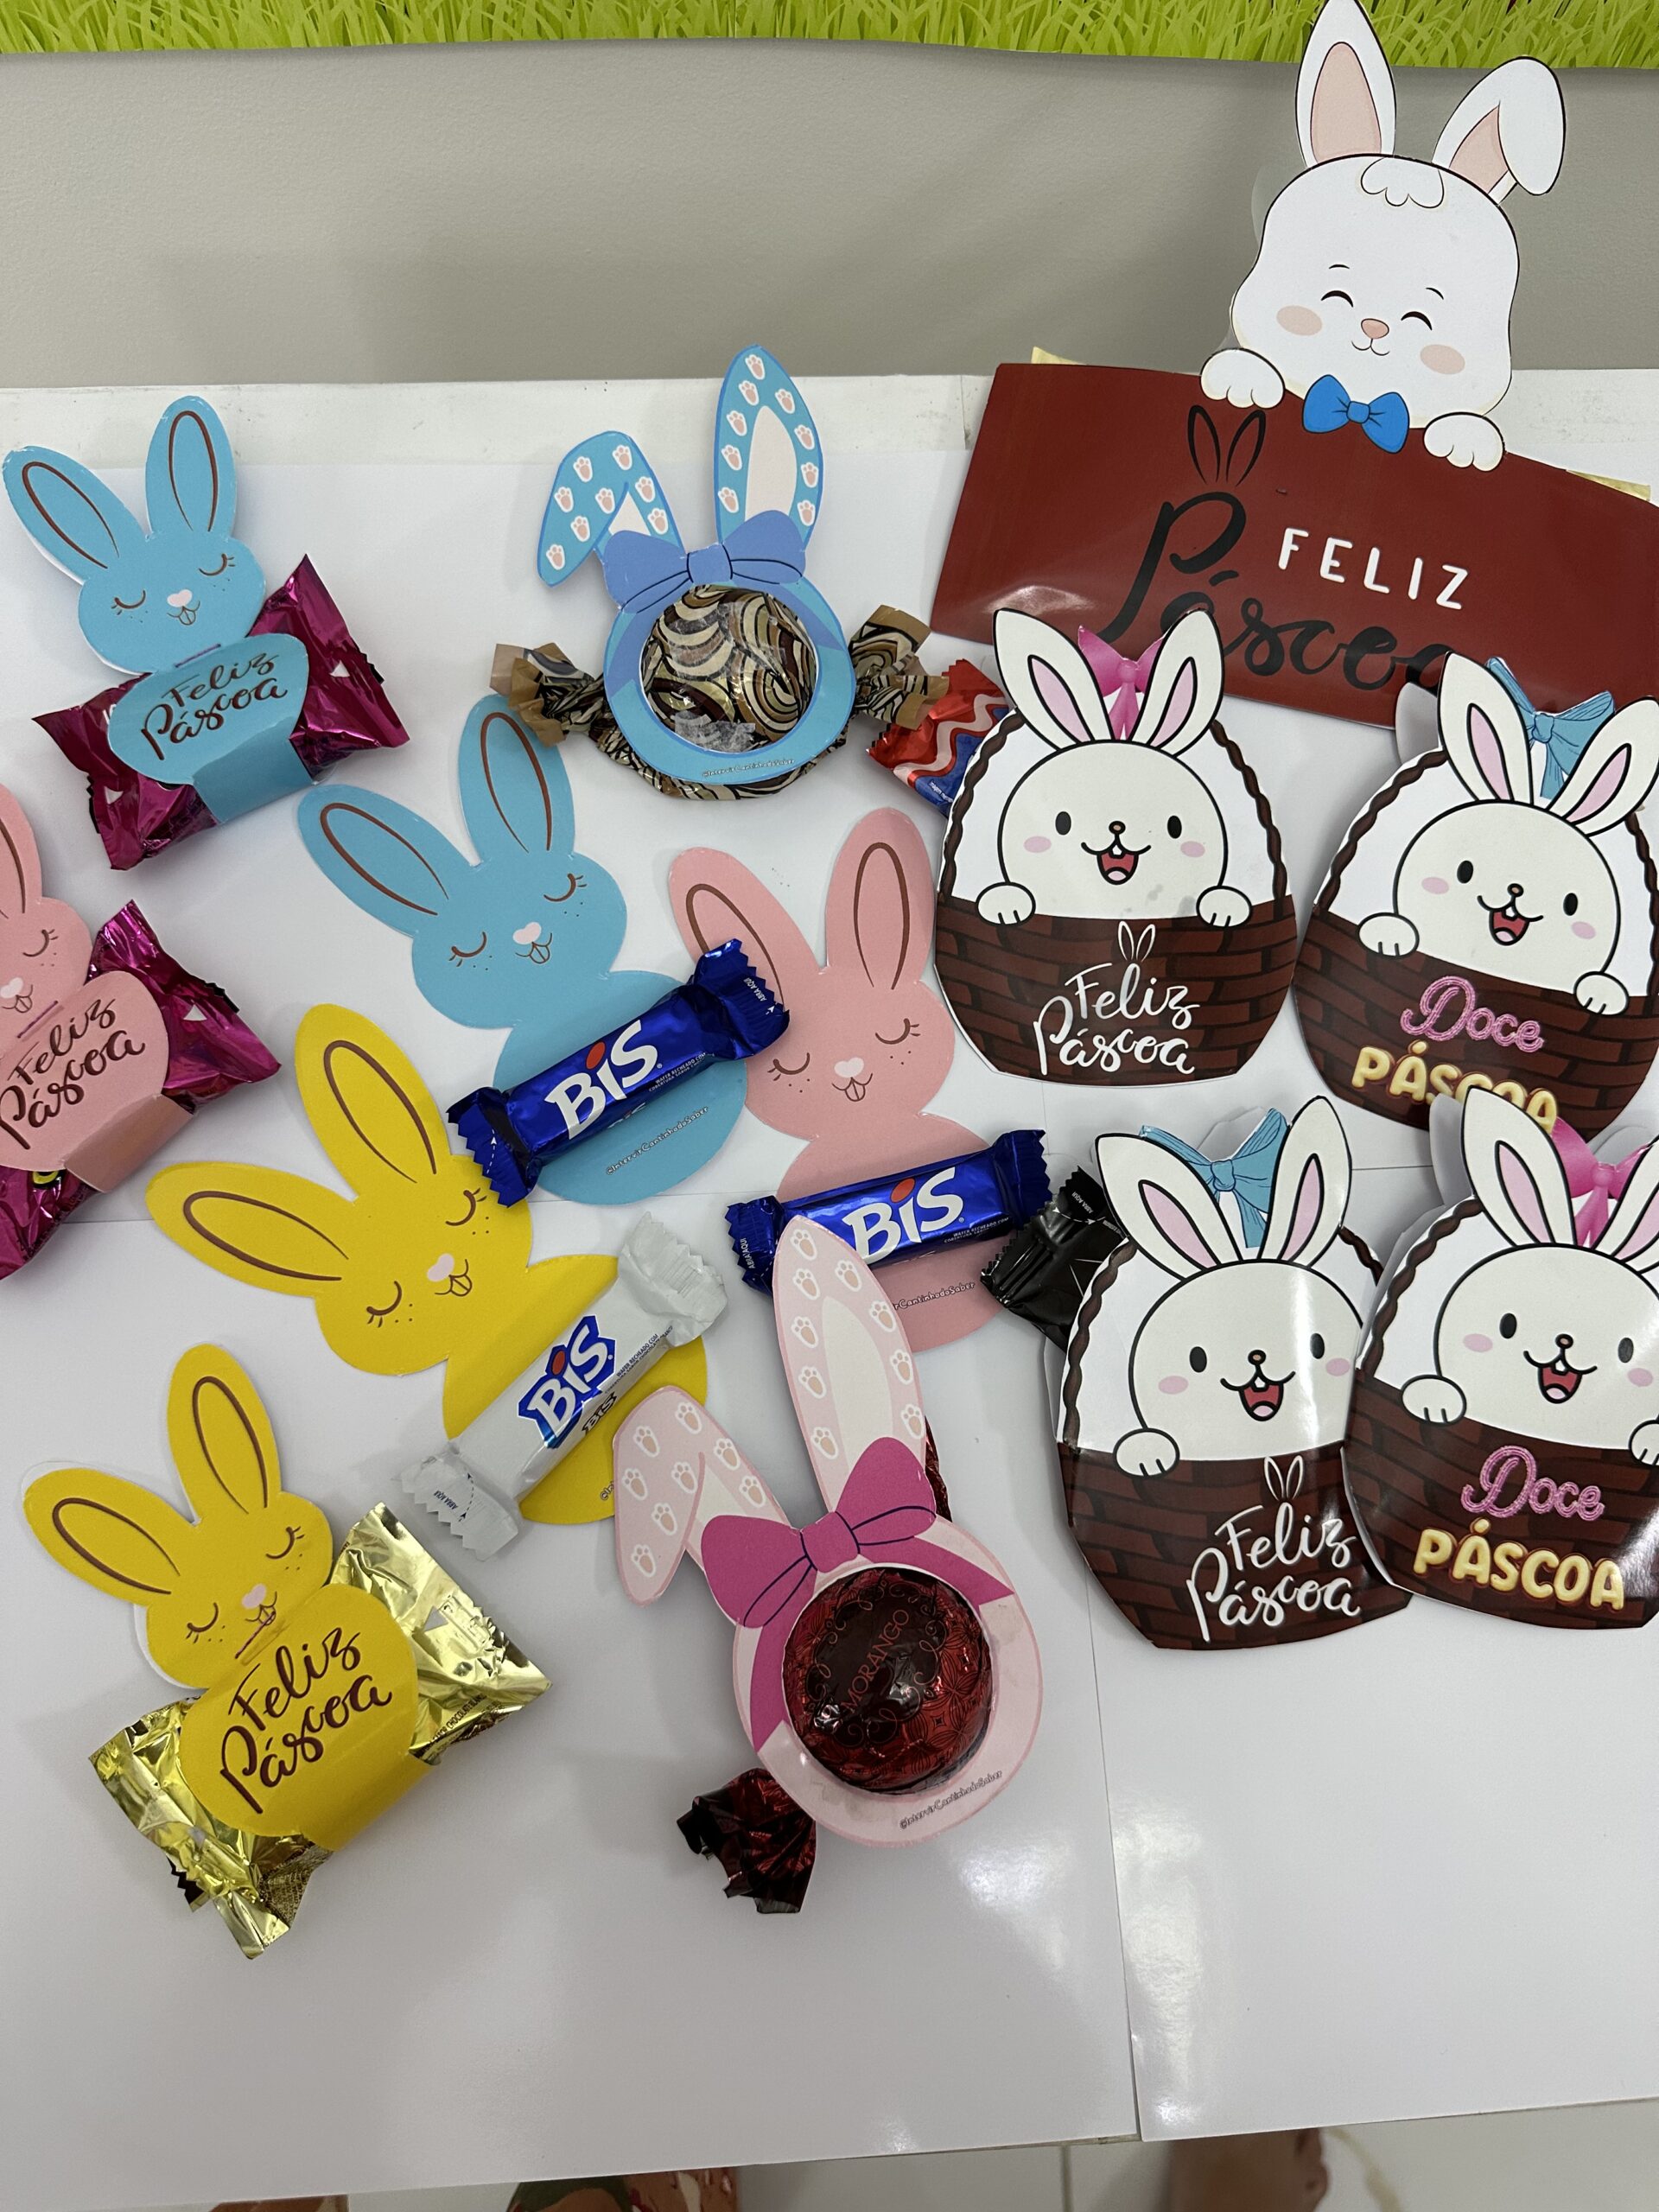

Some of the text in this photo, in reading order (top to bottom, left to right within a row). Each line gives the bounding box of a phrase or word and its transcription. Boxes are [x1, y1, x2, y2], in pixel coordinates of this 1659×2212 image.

[1278, 527, 1469, 610] FELIZ
[141, 675, 288, 760] Páscoa
[161, 652, 279, 707] Feliz
[1033, 996, 1195, 1076] Páscoa
[1065, 962, 1200, 1028] Feliz
[1400, 976, 1545, 1053] Doce
[7, 998, 117, 1085] Feliz
[0, 1030, 146, 1150] Páscoa
[617, 1363, 630, 1377] WAFER
[1460, 1445, 1605, 1522] Doce
[1215, 1502, 1358, 1571] Feliz
[1413, 1518, 1625, 1611] PÁSCOA
[1186, 1548, 1361, 1642] Páscoa
[228, 1626, 361, 1731] Feliz
[841, 1610, 909, 1713] MORANGO
[219, 1675, 393, 1815] Páscoa
